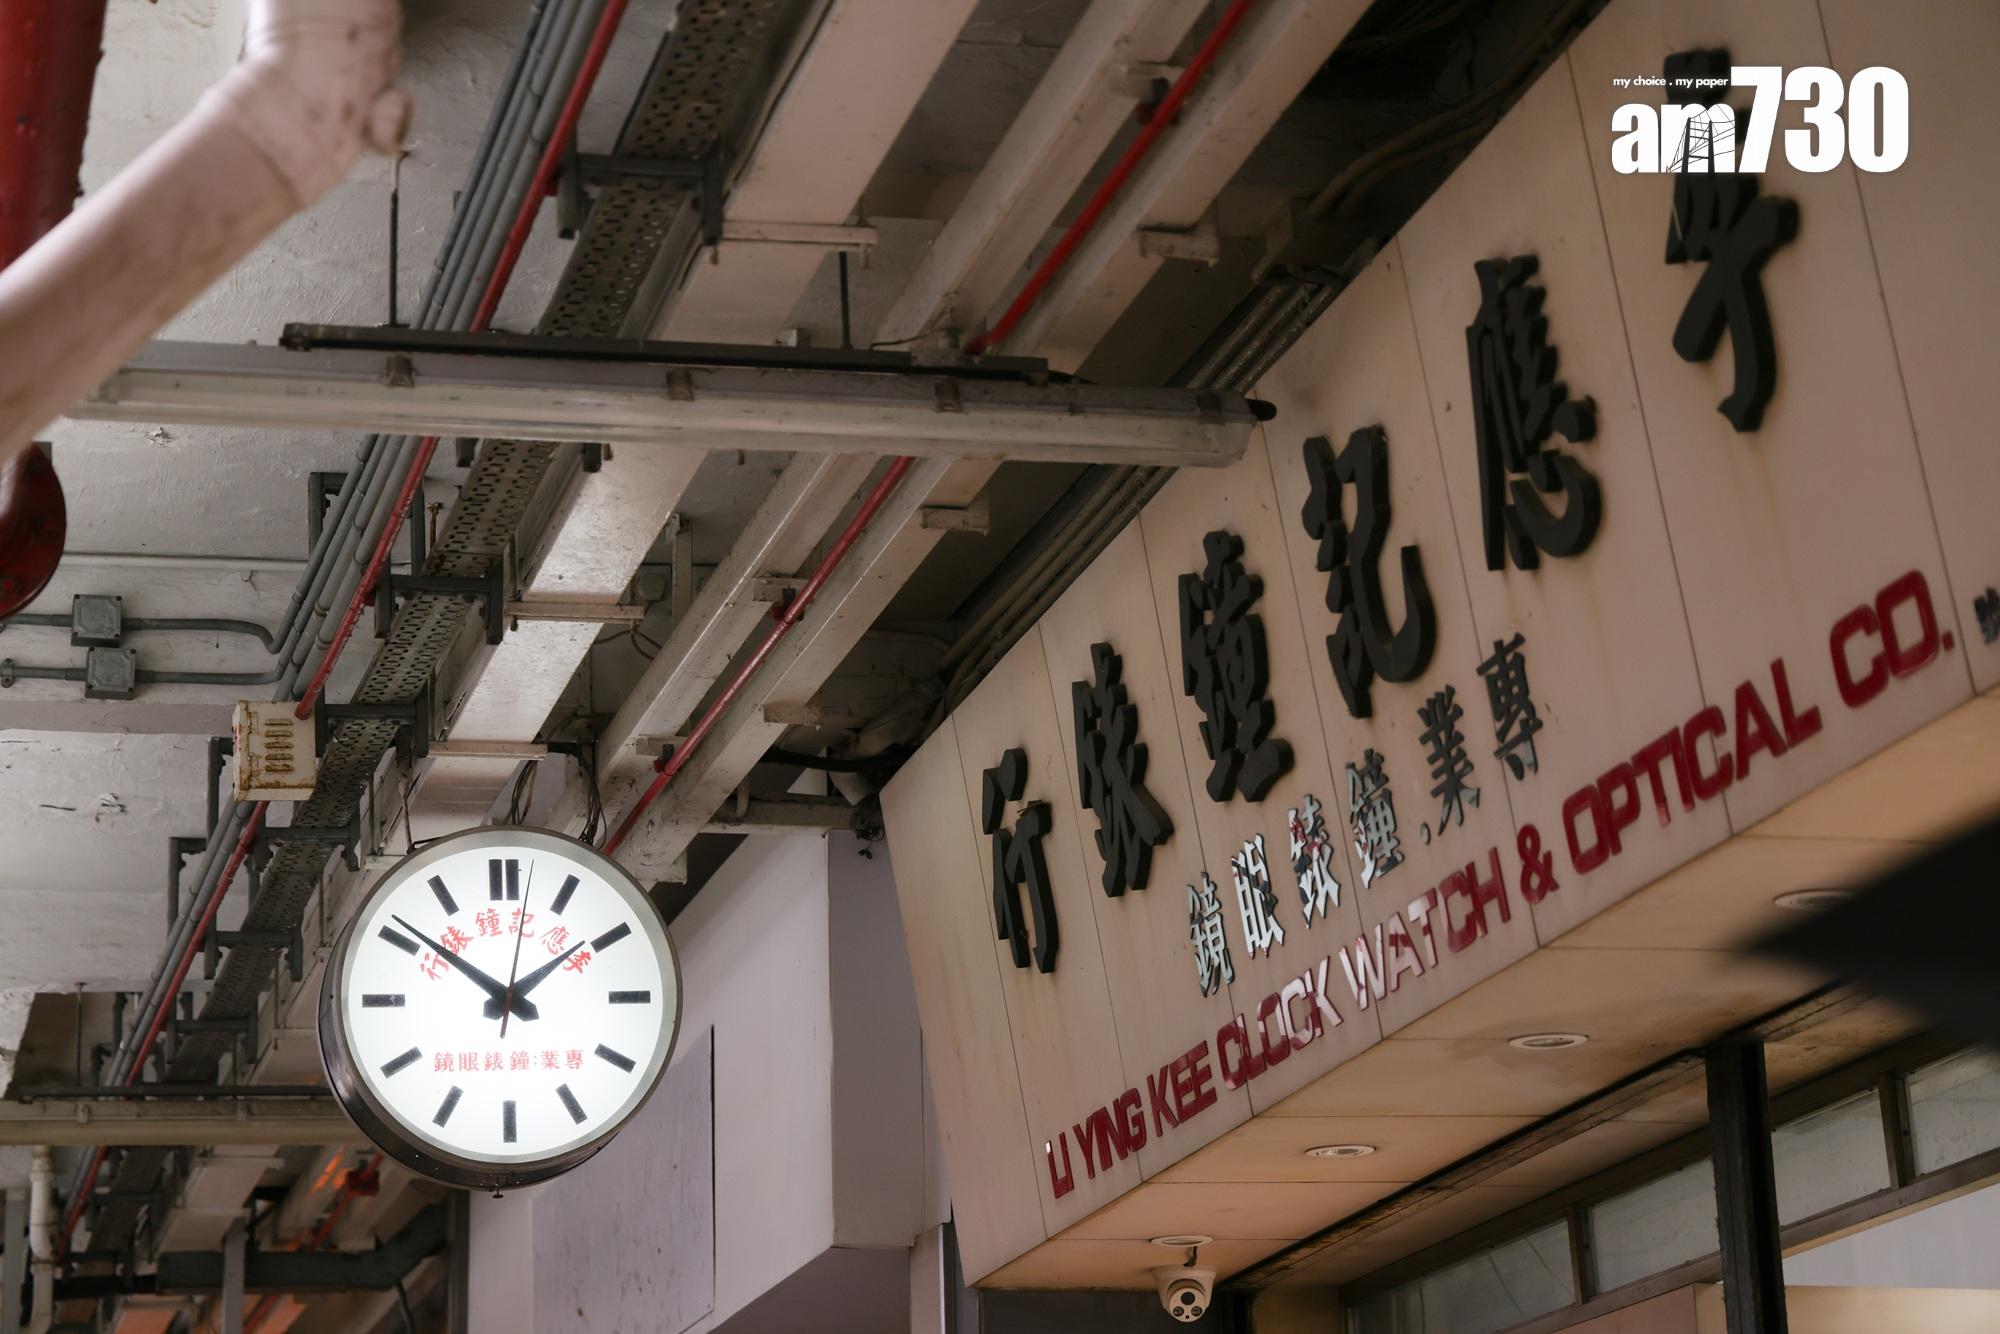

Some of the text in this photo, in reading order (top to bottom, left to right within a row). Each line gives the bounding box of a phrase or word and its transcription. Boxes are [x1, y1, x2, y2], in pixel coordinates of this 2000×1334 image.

[1045, 1131, 1074, 1198] LI
[1073, 1087, 1148, 1179] YING
[1146, 1040, 1218, 1138] KEE
[1217, 955, 1344, 1091] CLOCK
[1338, 847, 1511, 1011] WATCH
[1516, 824, 1560, 905] &
[1562, 657, 1823, 876] OPTICAL
[1830, 569, 1955, 709] CO.
